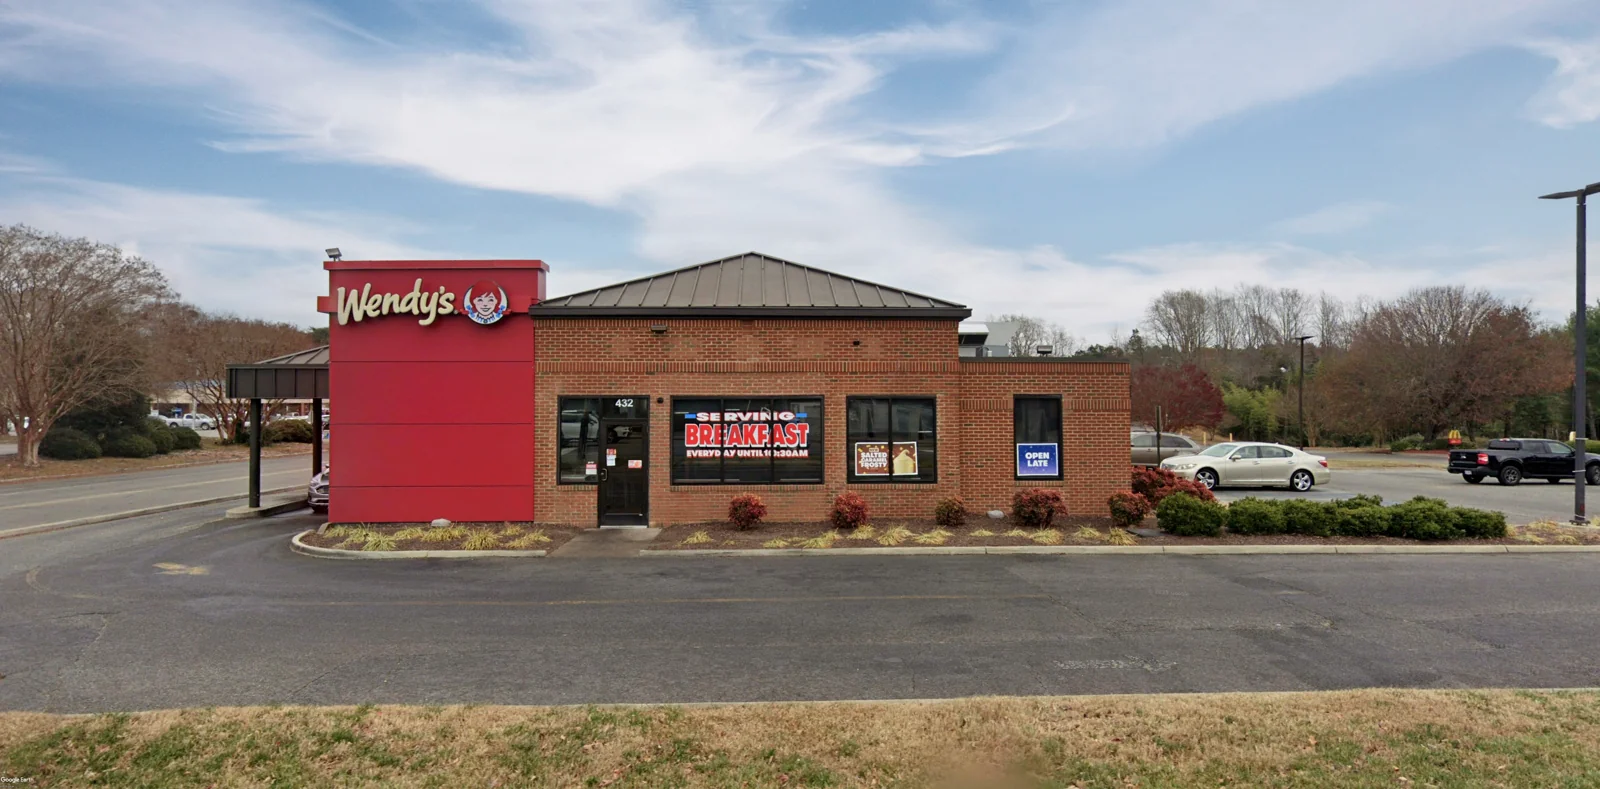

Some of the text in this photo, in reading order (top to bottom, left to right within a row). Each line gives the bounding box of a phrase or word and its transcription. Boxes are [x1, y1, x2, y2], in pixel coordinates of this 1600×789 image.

[337, 278, 455, 326] Wendy's
[615, 398, 634, 408] 432
[696, 411, 796, 422] SERVING
[685, 423, 810, 448] BREAKFAST
[686, 449, 736, 458] EVERYDAY
[737, 449, 764, 458] UNTIL
